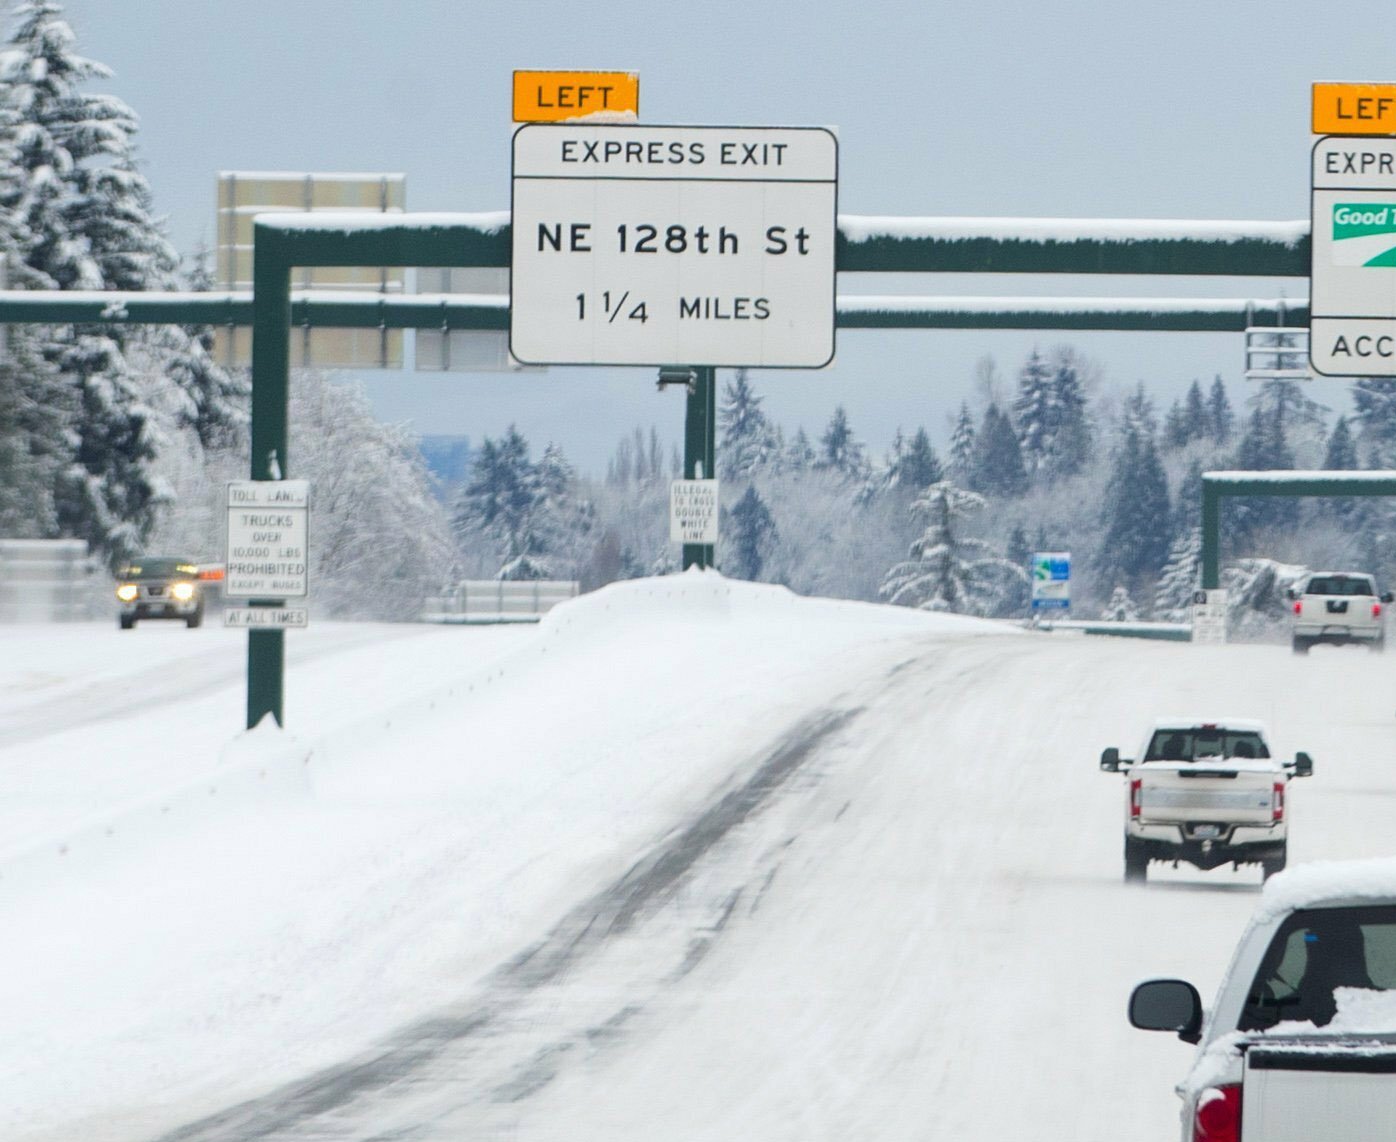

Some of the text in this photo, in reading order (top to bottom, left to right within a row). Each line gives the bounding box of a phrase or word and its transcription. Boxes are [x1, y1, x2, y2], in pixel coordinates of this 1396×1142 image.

[537, 86, 614, 108] LEFT
[561, 140, 789, 166] EXPRESS EXIT
[1335, 207, 1389, 226] Good
[537, 223, 811, 256] NE 128th St
[679, 297, 771, 320] MILES
[242, 514, 293, 527] TRUCKS
[253, 531, 282, 543] OVER
[278, 547, 301, 558] LBS
[229, 563, 305, 575] PROHIBITED
[229, 612, 305, 624] AT ALL TIMES
